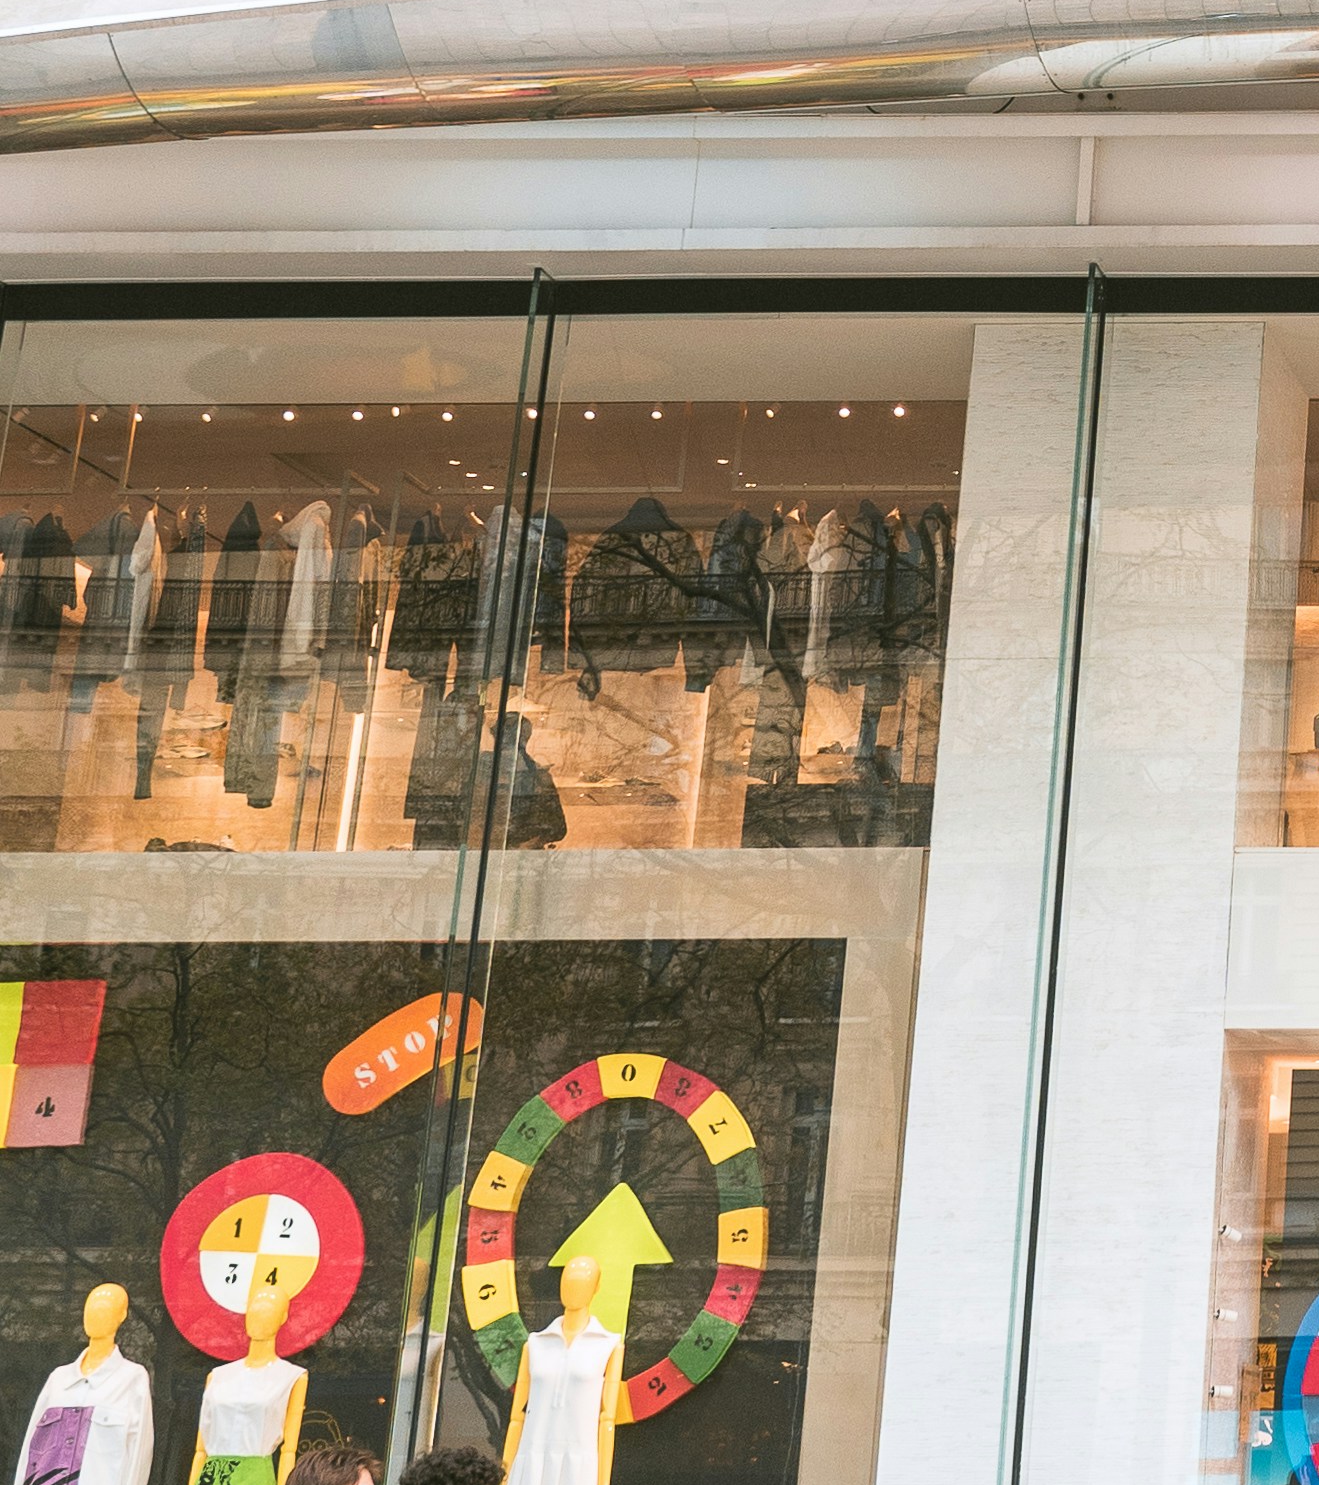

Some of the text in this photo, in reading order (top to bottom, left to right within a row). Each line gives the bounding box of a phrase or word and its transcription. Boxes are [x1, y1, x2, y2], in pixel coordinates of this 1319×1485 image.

[354, 1014, 453, 1089] STOP
[35, 1097, 55, 1117] 4
[233, 1217, 294, 1238] 1 2
[225, 1263, 279, 1286] 3 4
